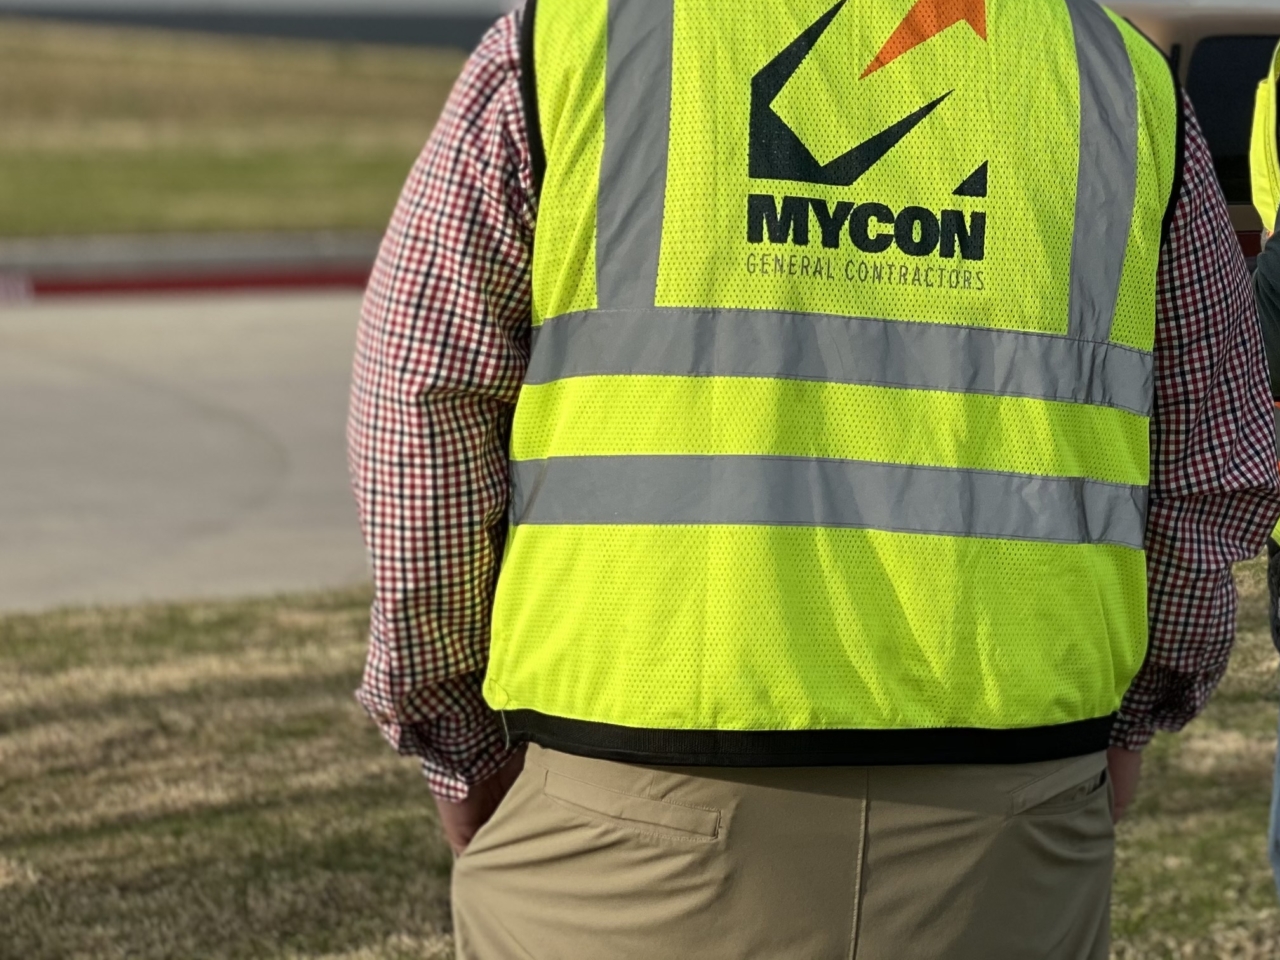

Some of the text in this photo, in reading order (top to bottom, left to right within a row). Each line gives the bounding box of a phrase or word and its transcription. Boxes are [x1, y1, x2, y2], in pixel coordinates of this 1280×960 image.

[747, 194, 986, 261] MYCON
[747, 253, 985, 290] GENERAL CONTRACTORS
